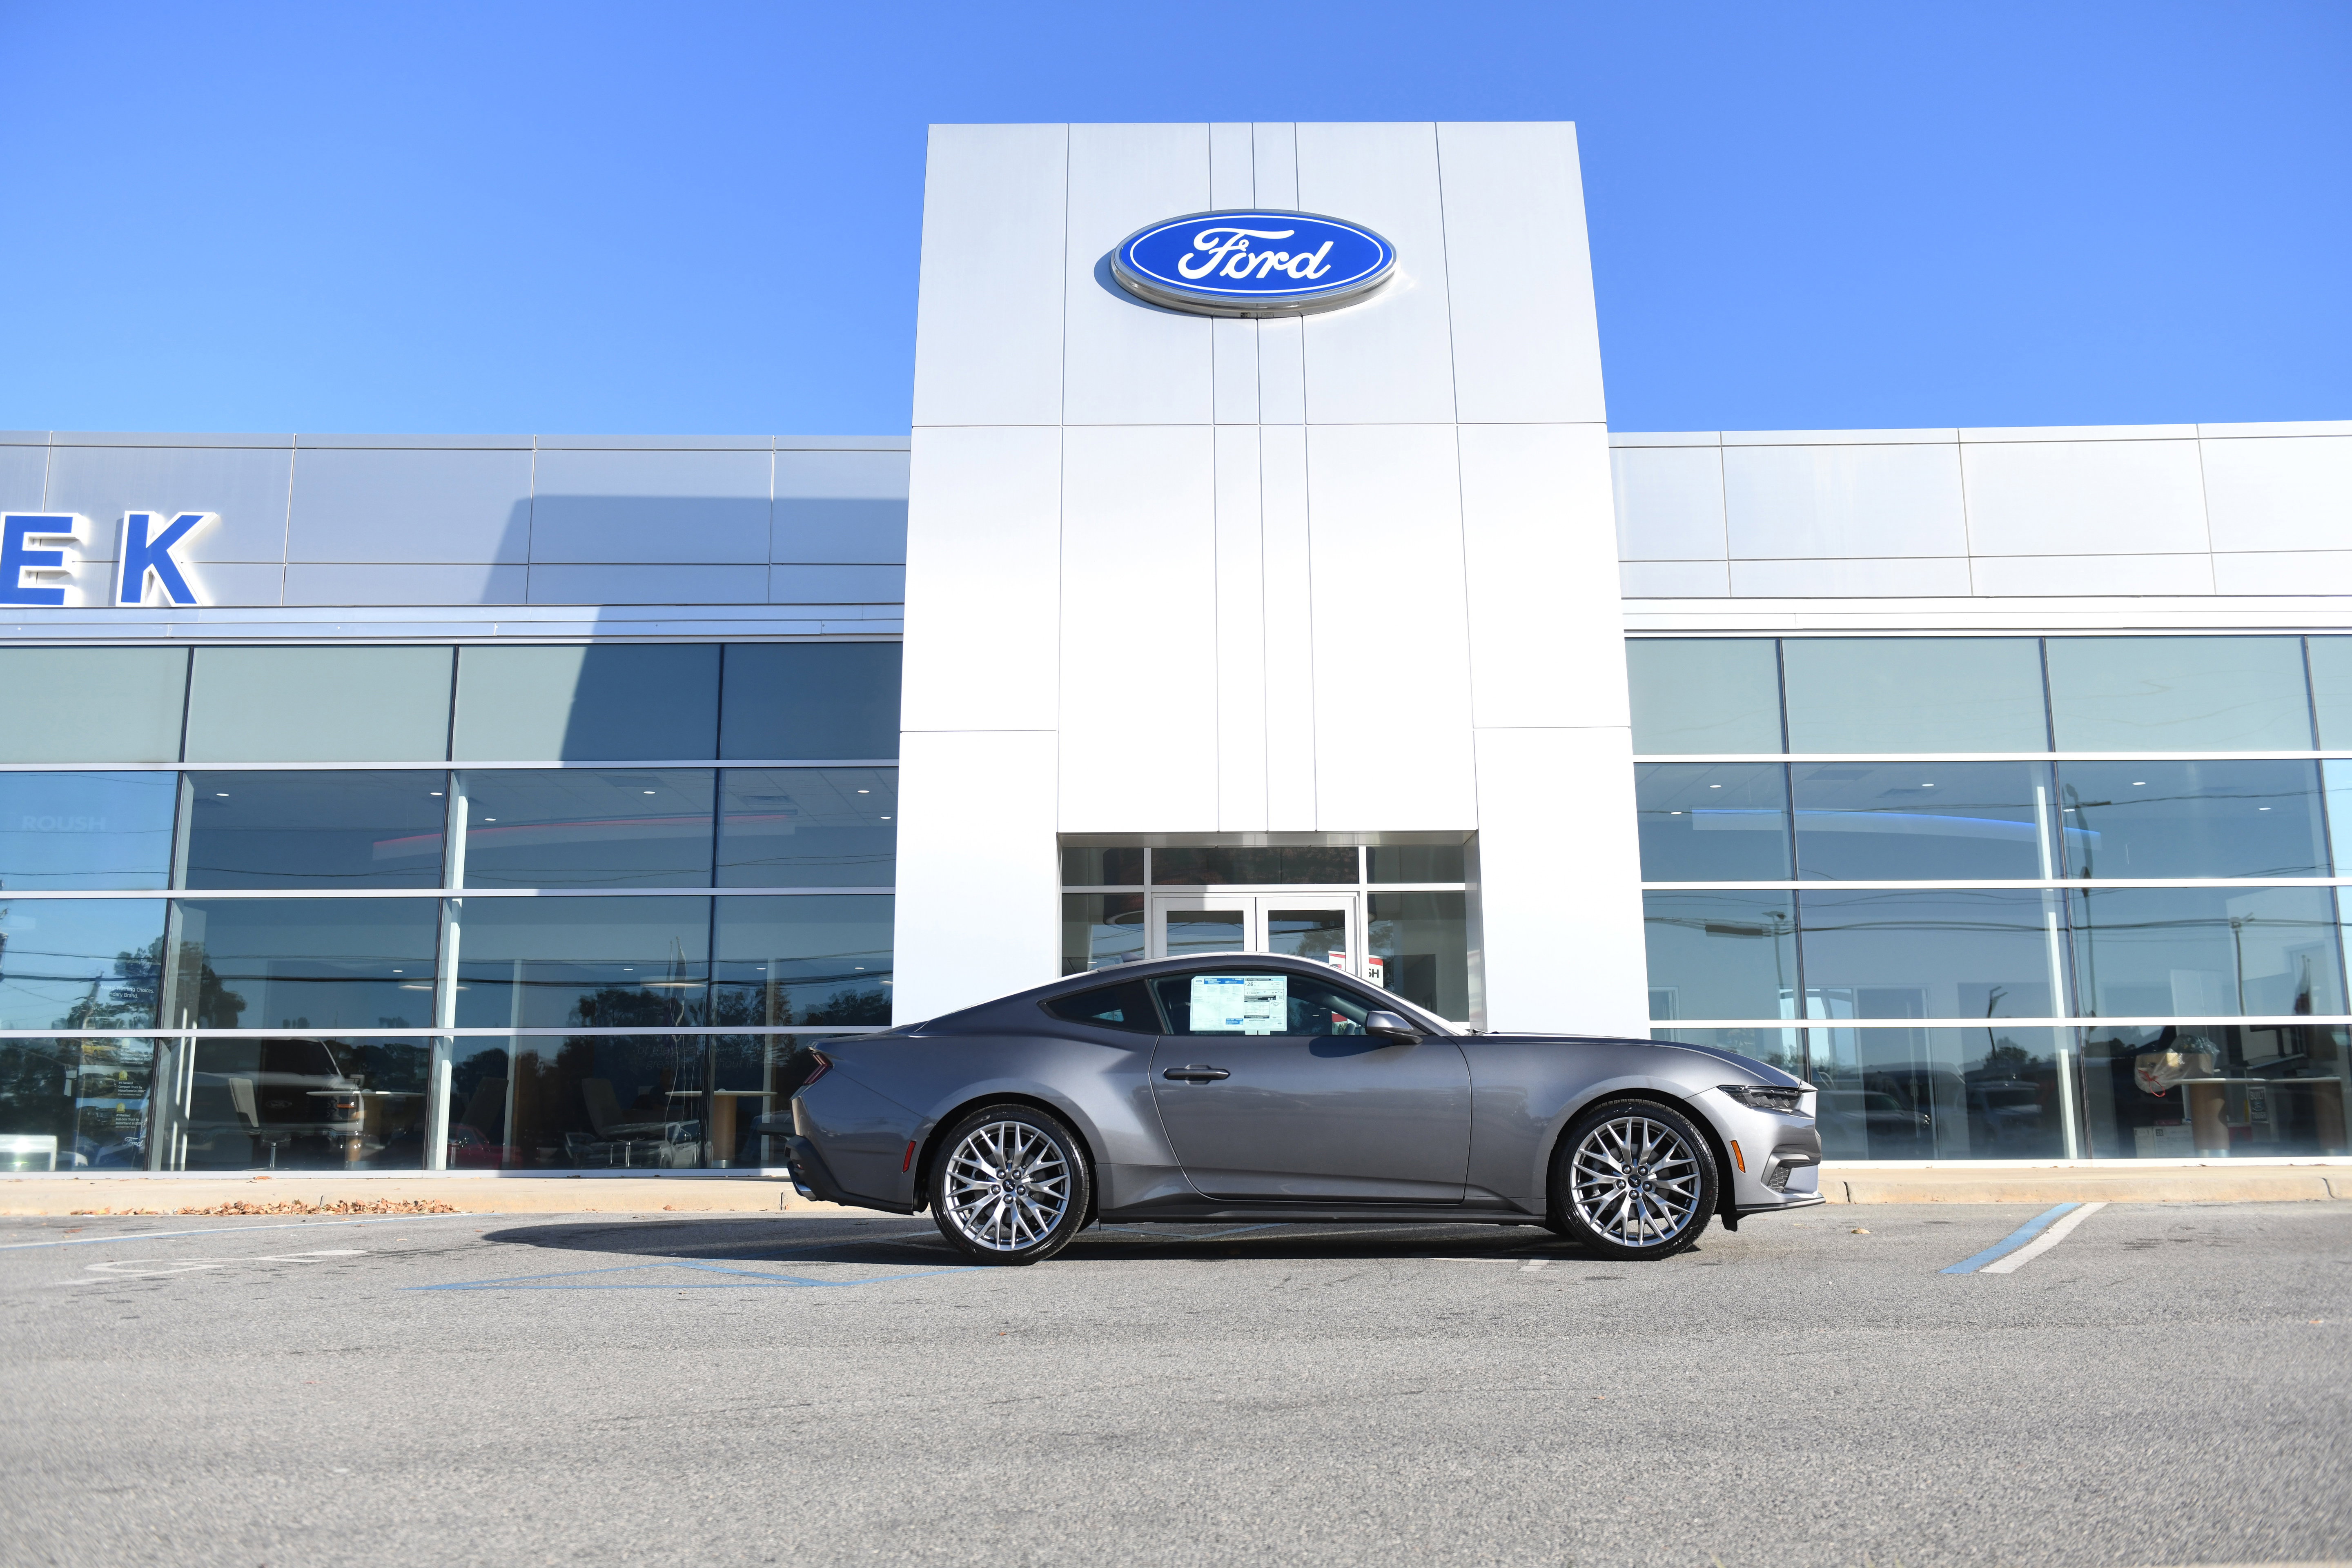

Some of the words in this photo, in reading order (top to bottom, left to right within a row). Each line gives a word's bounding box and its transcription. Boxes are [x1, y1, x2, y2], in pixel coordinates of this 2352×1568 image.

[1178, 227, 1334, 279] Ford
[22, 815, 106, 831] ROUSH
[100, 984, 136, 993] Award-Winning
[645, 1059, 698, 1071] greatness
[2250, 1091, 2265, 1100] BUILT
[123, 1136, 144, 1147] Ford
